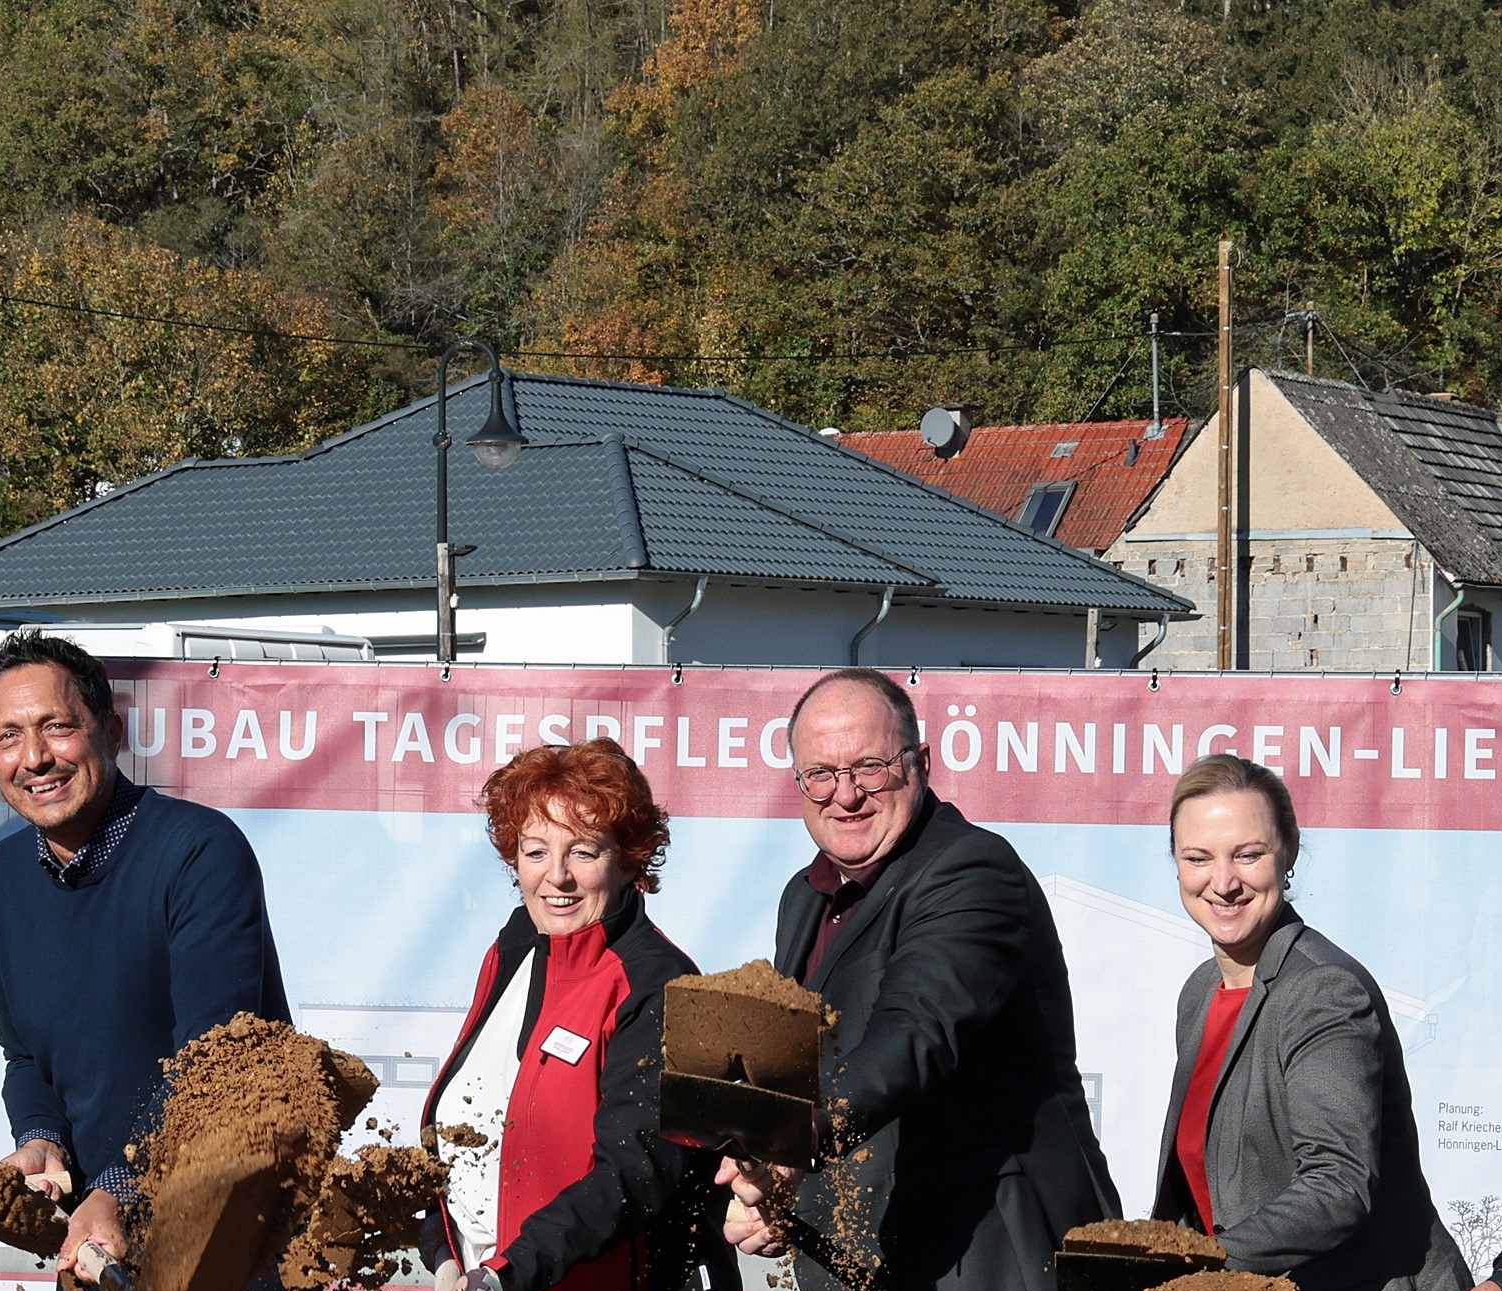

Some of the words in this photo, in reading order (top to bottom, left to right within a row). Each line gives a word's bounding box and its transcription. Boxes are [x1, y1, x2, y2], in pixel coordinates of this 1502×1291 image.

[127, 707, 319, 761] UBAU
[353, 710, 795, 769] TAGESPFLEG
[1438, 1102, 1484, 1117] Planung:
[1438, 1120, 1459, 1132] Ralf
